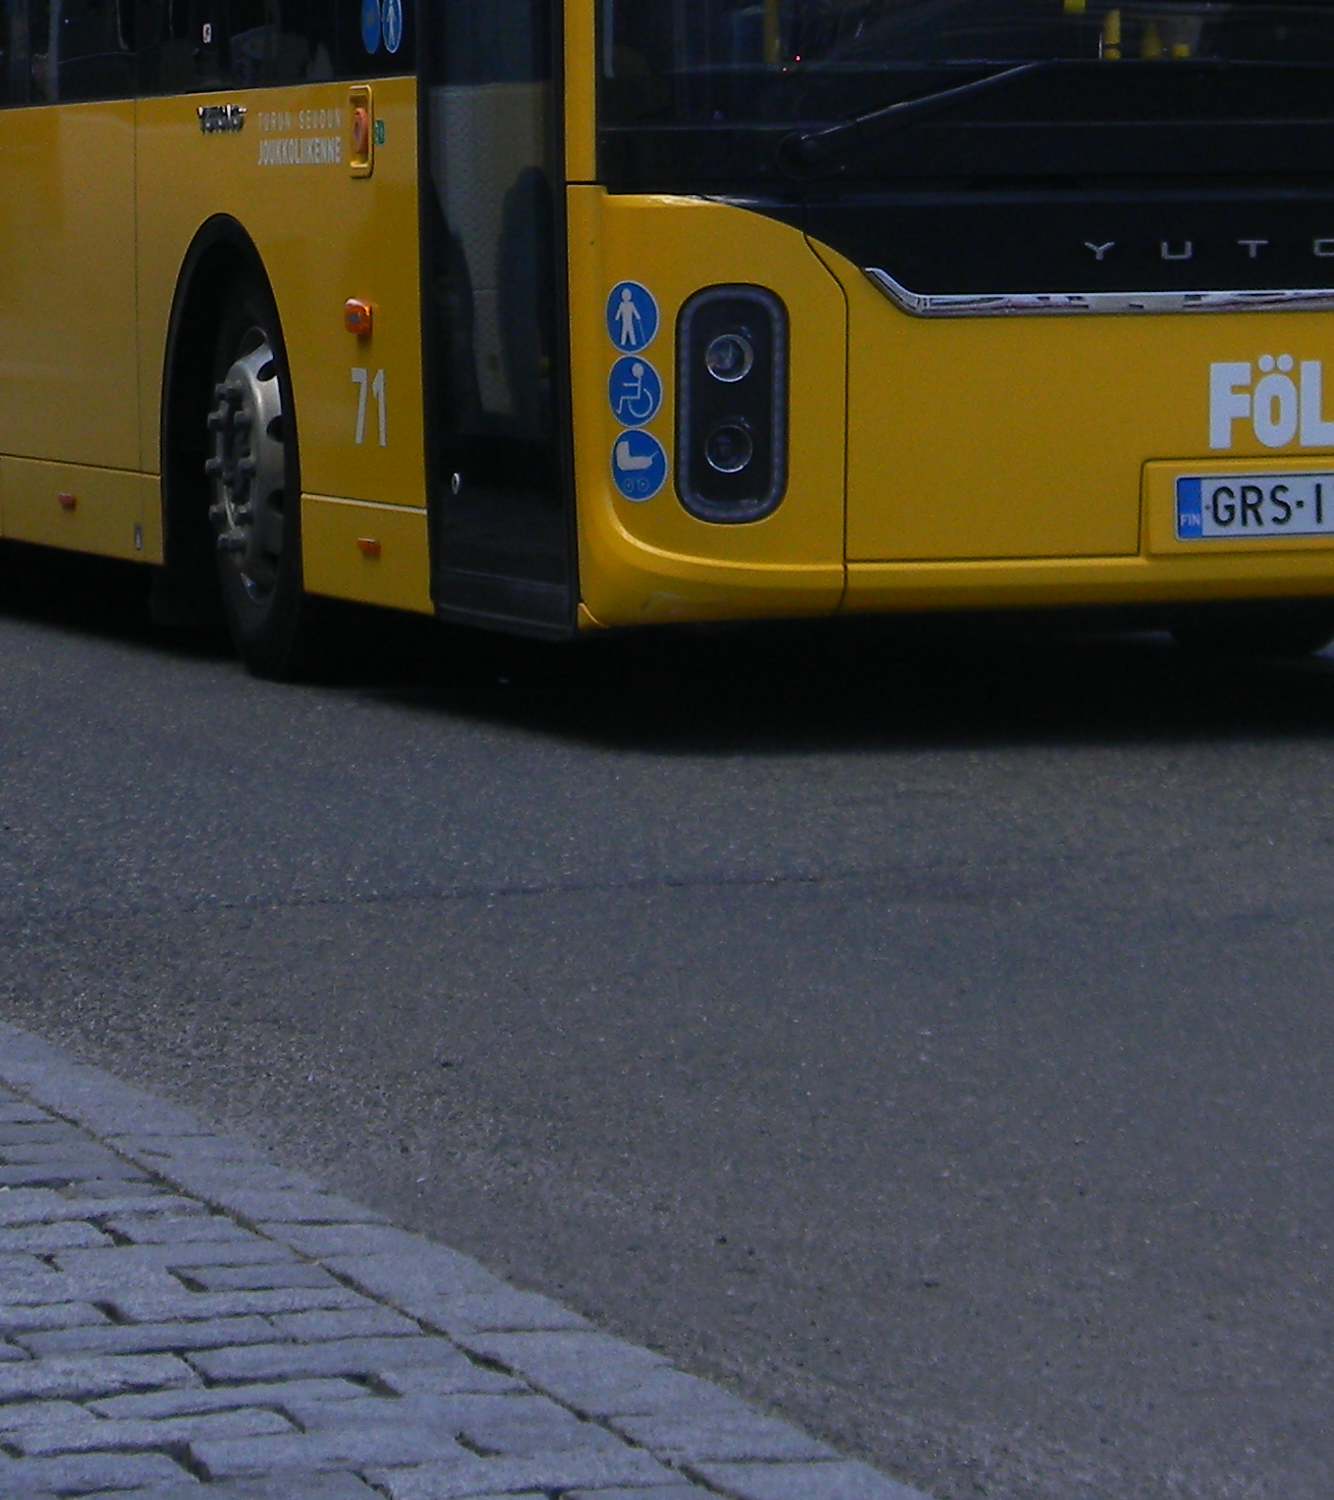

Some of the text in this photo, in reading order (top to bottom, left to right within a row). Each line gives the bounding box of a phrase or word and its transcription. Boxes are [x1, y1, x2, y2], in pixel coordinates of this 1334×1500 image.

[258, 110, 292, 132] TURUN
[258, 136, 342, 166] JOUKKOLIIKENNE
[350, 366, 388, 447] 71
[1179, 513, 1201, 527] FIN
